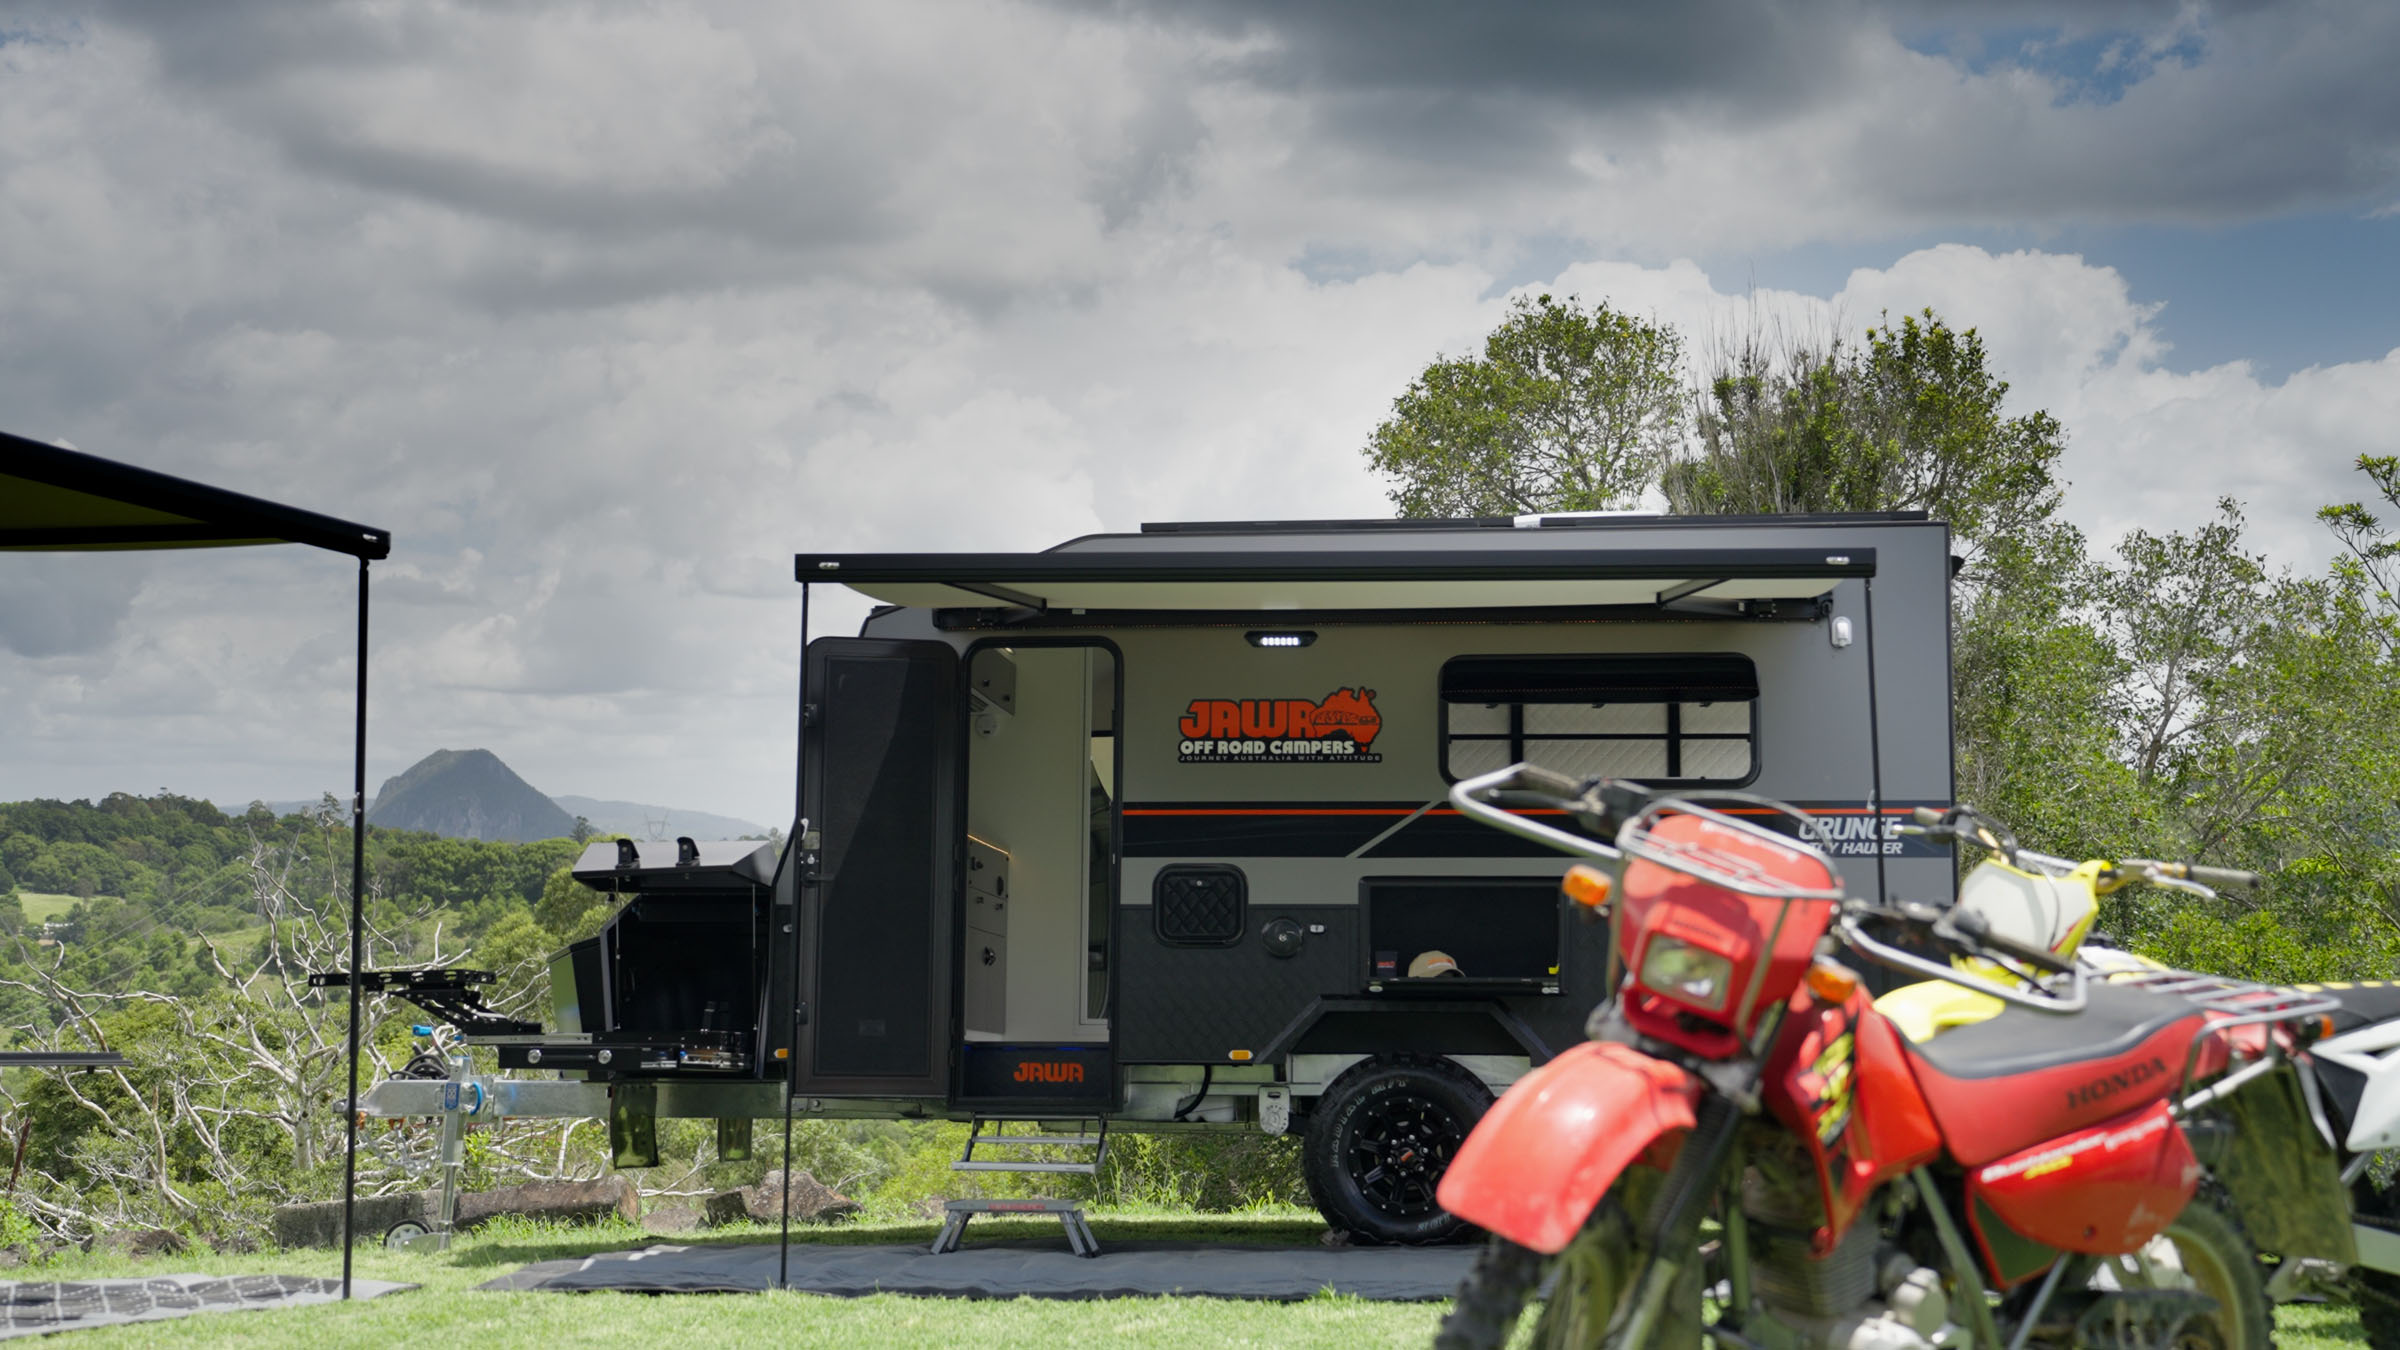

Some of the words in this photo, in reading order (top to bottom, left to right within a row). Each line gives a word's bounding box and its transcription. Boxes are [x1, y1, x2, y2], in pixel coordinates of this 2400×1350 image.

[1180, 700, 1318, 739] JAWA
[1180, 740, 1215, 755] OFF
[1217, 740, 1266, 755] ROAD
[1269, 740, 1356, 755] CAMPERS
[1013, 1062, 1084, 1082] JAWA
[2065, 1056, 2167, 1110] HONDA
